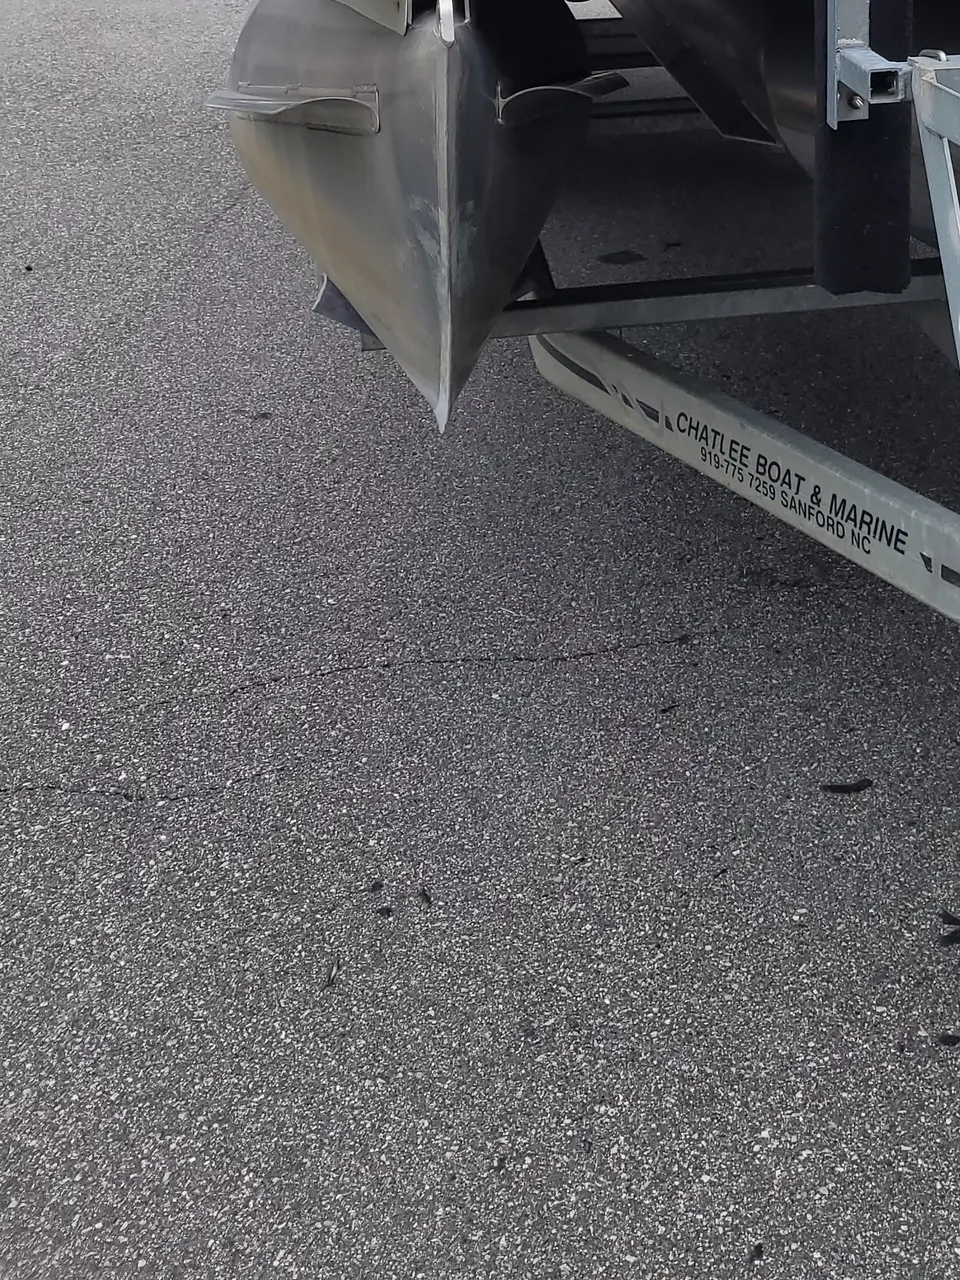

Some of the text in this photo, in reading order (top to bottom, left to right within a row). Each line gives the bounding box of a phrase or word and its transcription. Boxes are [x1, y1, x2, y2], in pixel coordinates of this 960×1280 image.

[676, 411, 909, 556] CHATLEE BOAT & MARINE
[700, 445, 871, 555] 919-775 7259 SANFORD NC
